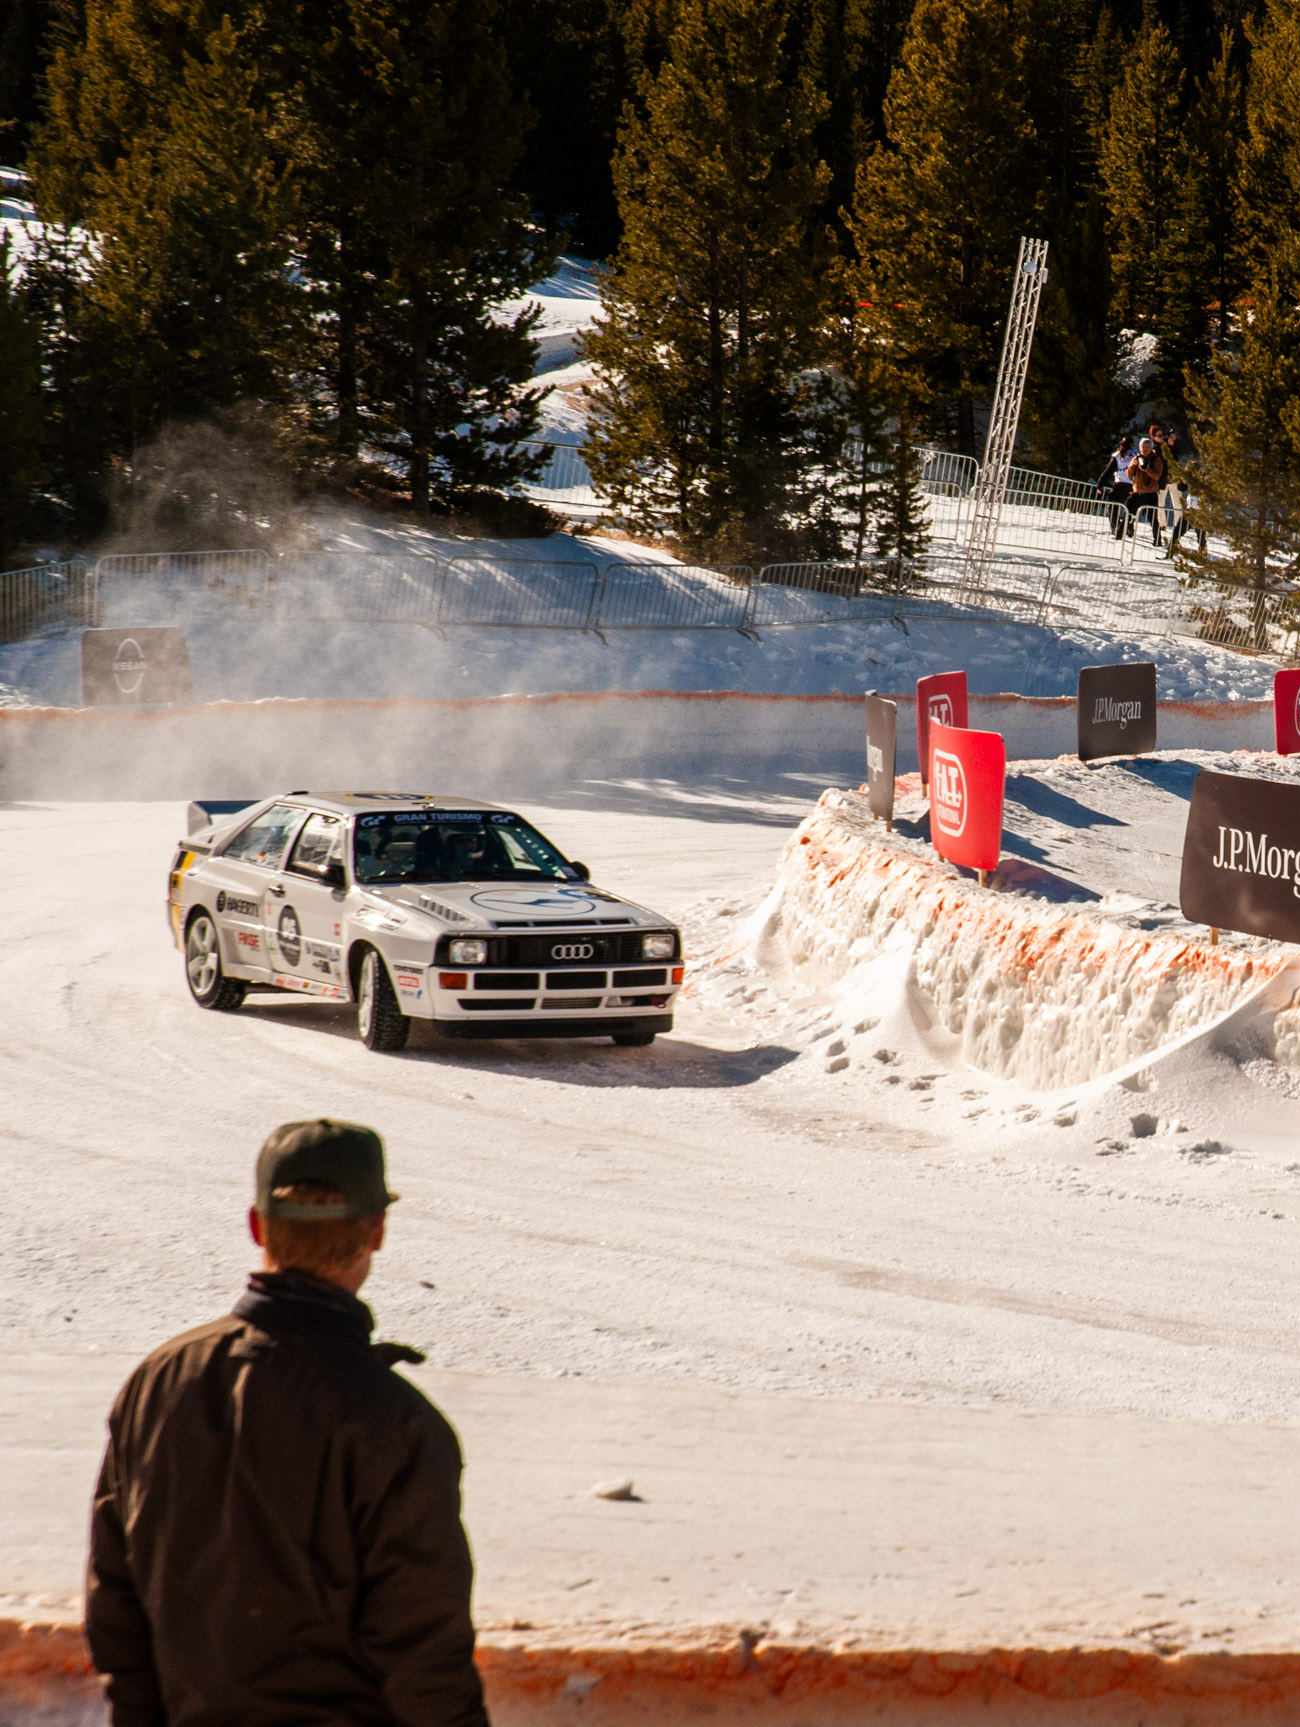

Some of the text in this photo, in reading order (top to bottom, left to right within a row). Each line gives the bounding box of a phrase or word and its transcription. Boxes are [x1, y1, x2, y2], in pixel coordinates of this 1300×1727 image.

[1093, 697, 1141, 729] J.P.Morgan
[394, 813, 482, 822] GRAN TURISMO
